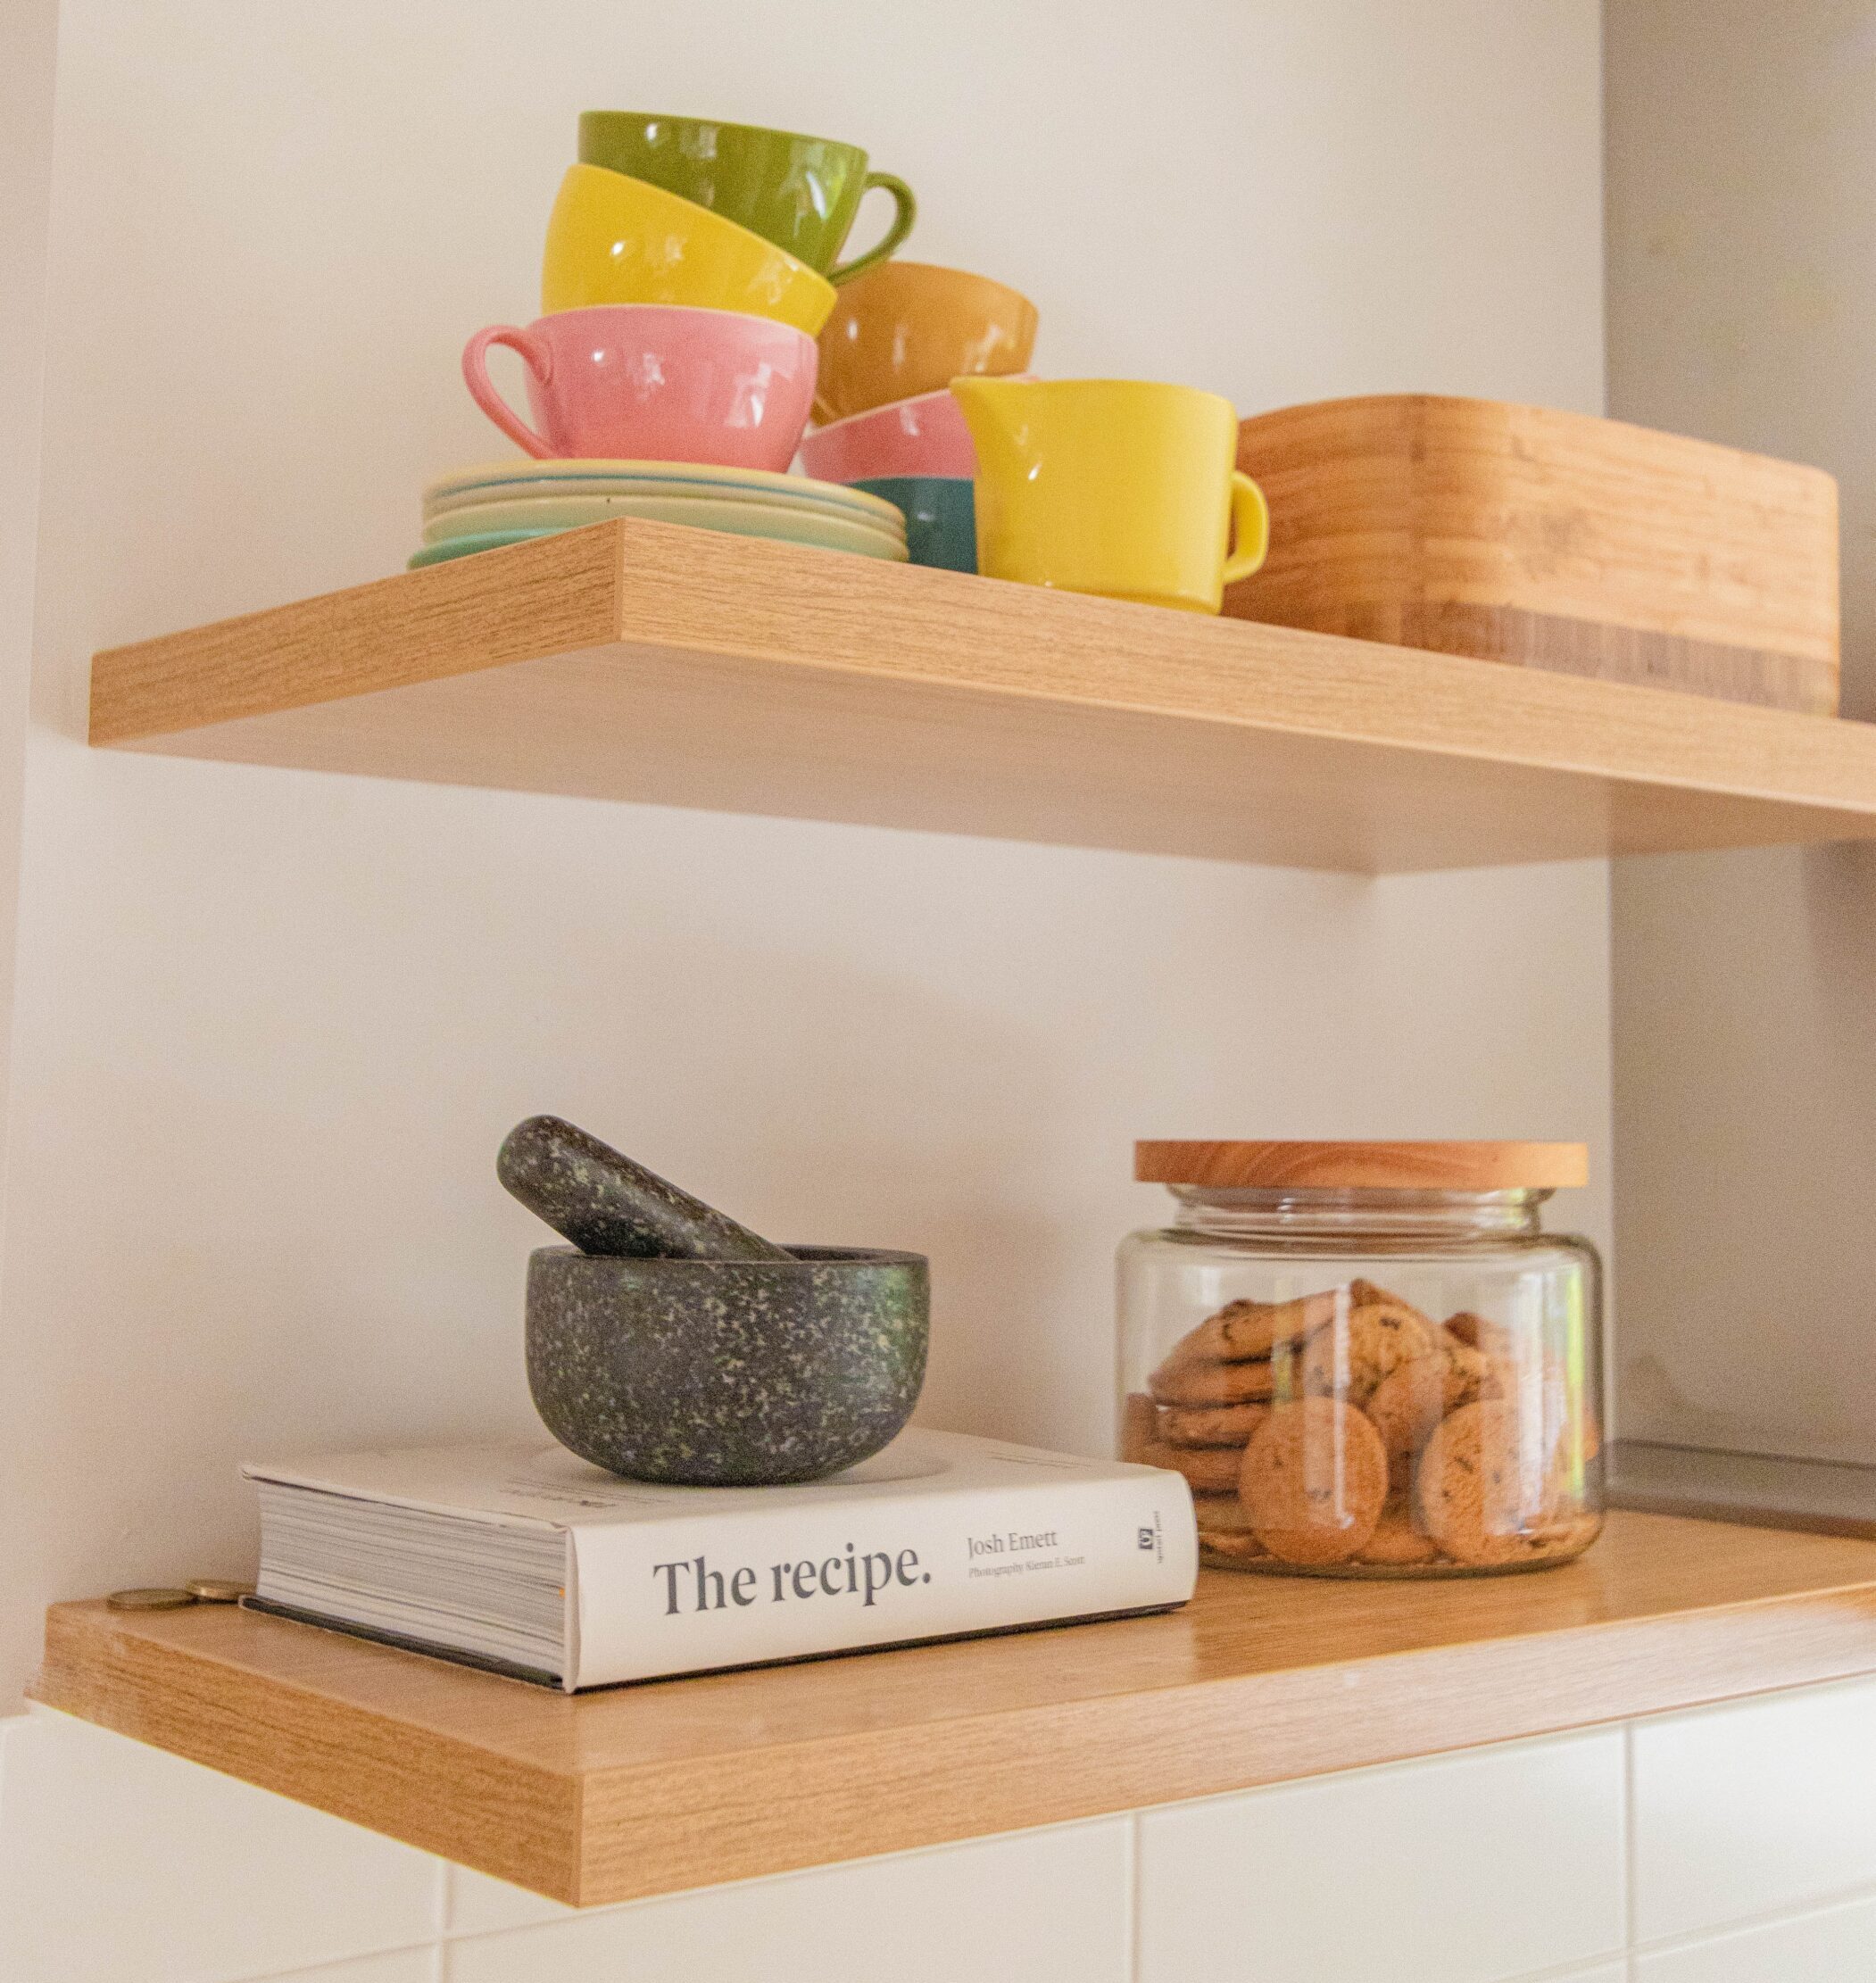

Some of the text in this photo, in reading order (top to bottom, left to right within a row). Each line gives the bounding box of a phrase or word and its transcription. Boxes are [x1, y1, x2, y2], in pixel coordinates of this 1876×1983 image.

[967, 1531, 1058, 1559] Josh Emett
[652, 1542, 932, 1615] The recipe.
[968, 1563, 1023, 1578] Photography
